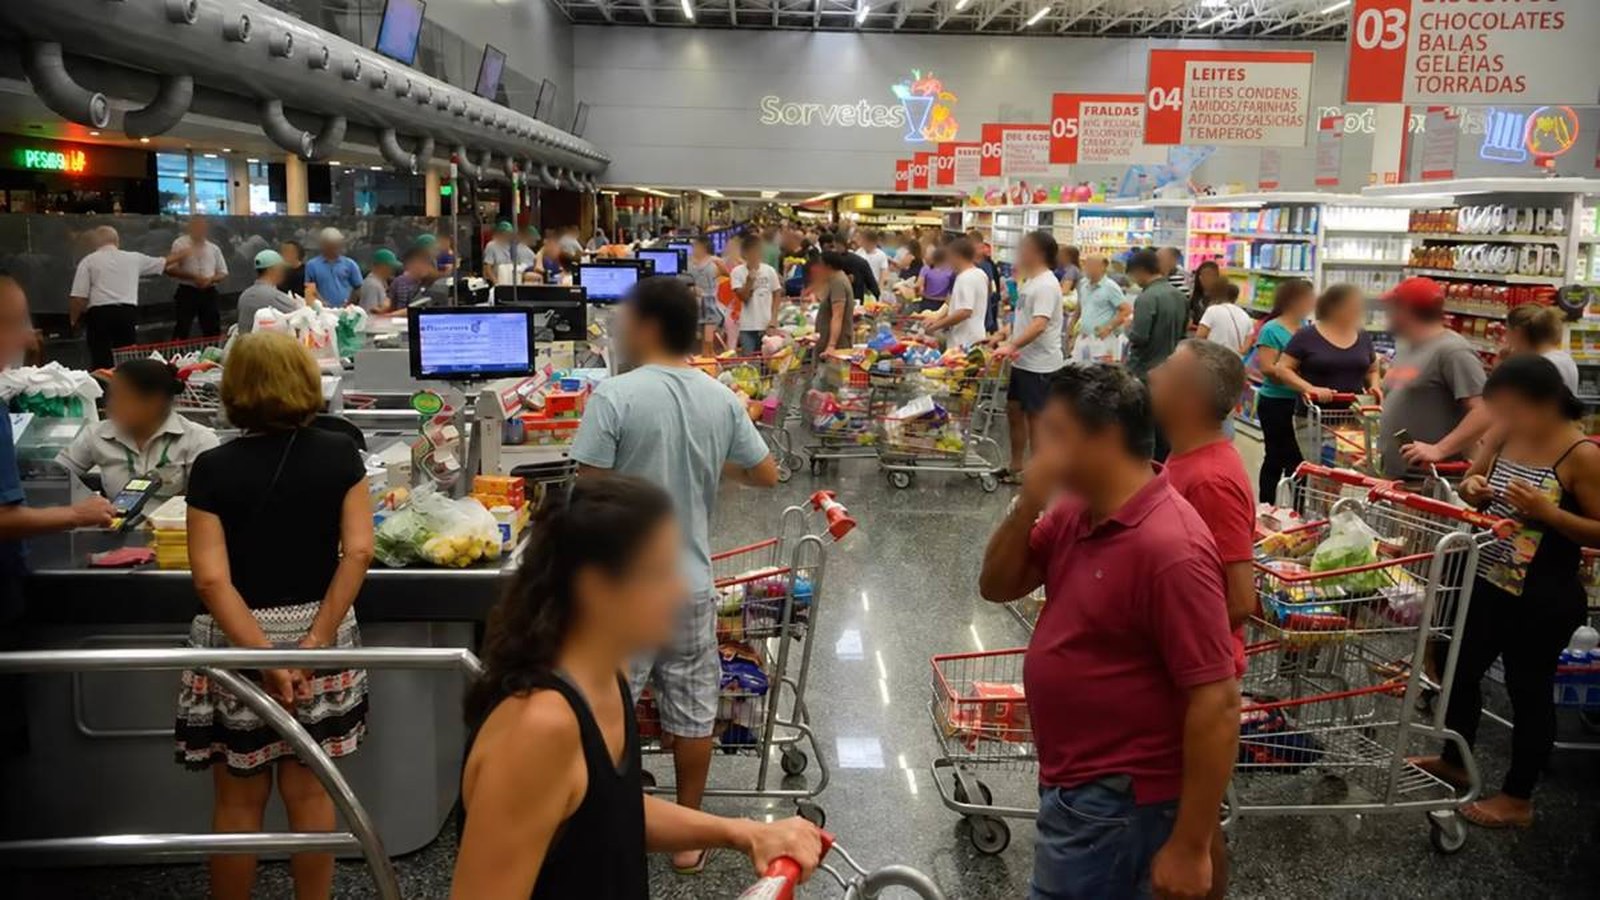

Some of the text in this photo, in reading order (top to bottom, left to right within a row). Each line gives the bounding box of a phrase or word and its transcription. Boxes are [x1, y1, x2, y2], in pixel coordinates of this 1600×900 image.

[1356, 8, 1407, 50] 03
[1419, 12, 1565, 30] CHOCOLATES
[1418, 34, 1488, 52] BALAS
[1416, 52, 1504, 73] GELÉIAS
[1192, 68, 1246, 81] LEITES
[1190, 87, 1234, 99] LEITES
[1415, 75, 1526, 93] TORRADAS
[1149, 86, 1182, 112] 04
[760, 95, 906, 128] Sorvetes
[1084, 106, 1140, 117] FRALDAS
[1052, 117, 1078, 138] 05
[1188, 127, 1263, 140] TEMPEROS
[982, 142, 1001, 158] 06
[938, 156, 954, 170] 07
